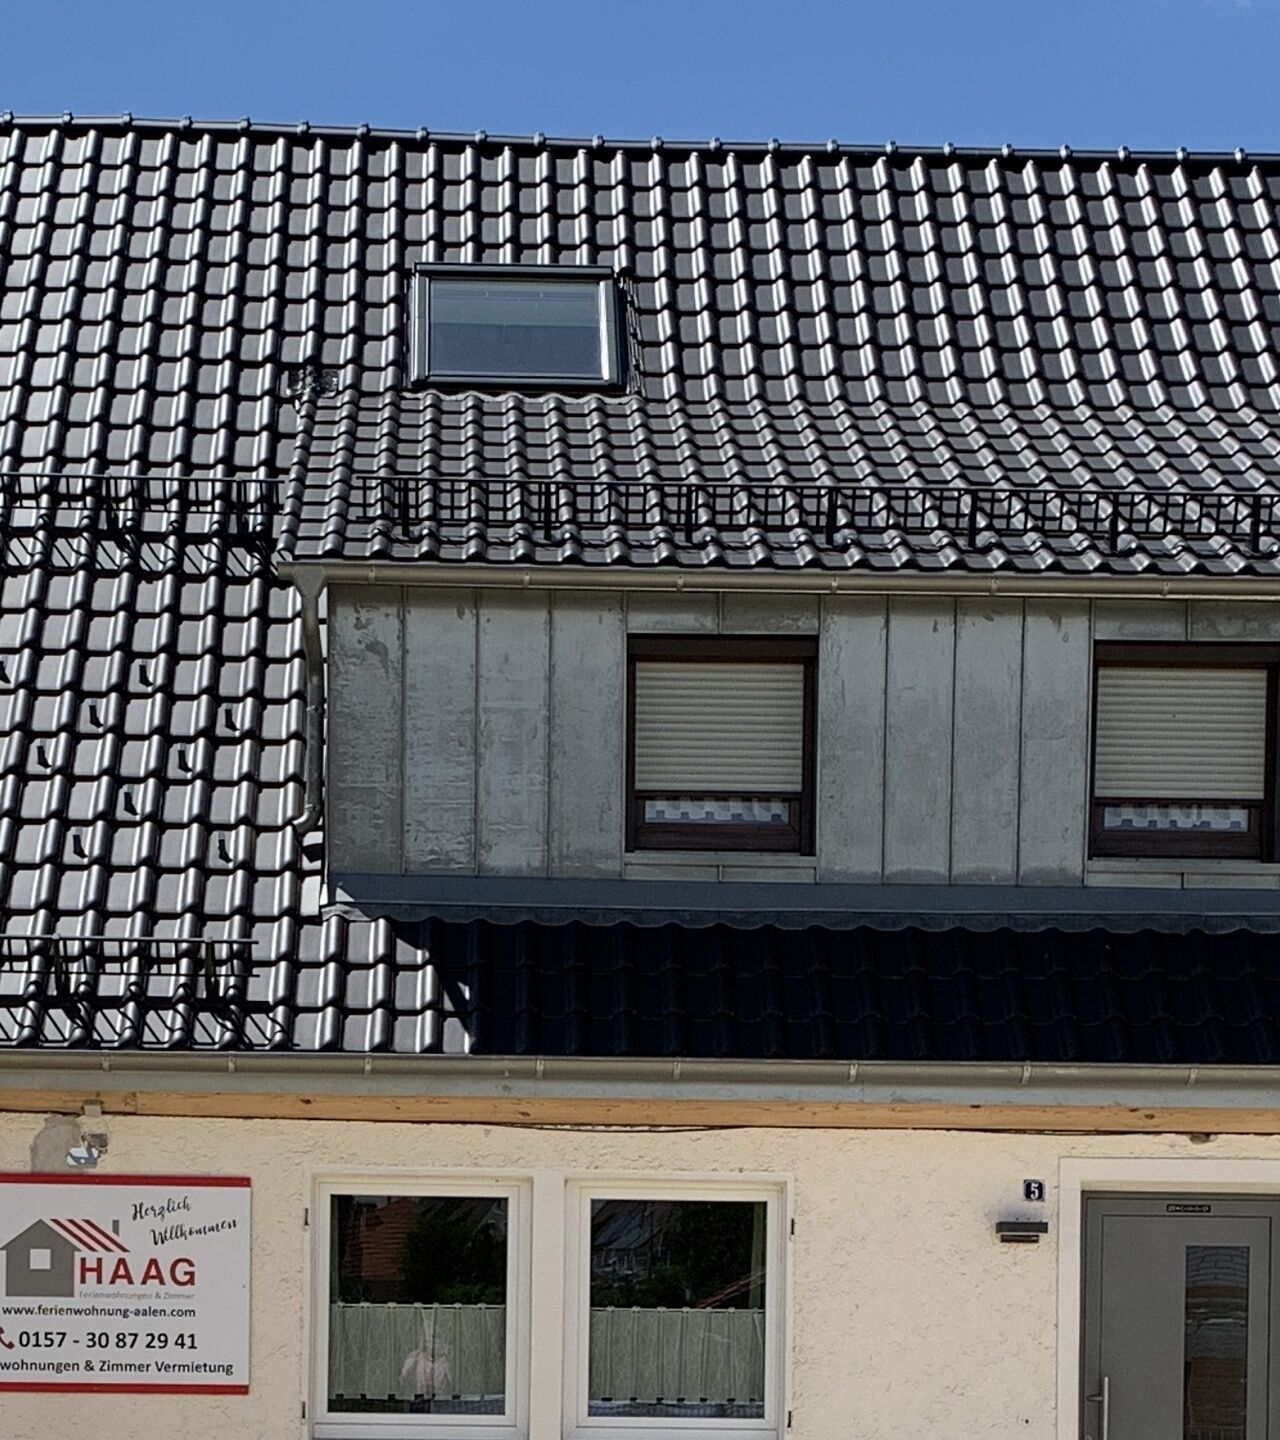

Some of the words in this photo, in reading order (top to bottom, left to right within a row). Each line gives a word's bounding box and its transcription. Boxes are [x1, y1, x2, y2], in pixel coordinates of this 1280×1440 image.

[131, 1195, 192, 1223] Herzlich
[79, 1257, 197, 1287] HAAG
[1, 1304, 197, 1319] www.ferienwohnung-aalen.com
[18, 1331, 67, 1348] 0157
[85, 1332, 109, 1349] 30
[115, 1332, 139, 1349] 87
[145, 1332, 169, 1350] 29
[173, 1333, 198, 1350] 41
[83, 1359, 95, 1372] &
[99, 1359, 151, 1373] Zimmer
[154, 1360, 234, 1376] Vermietung
